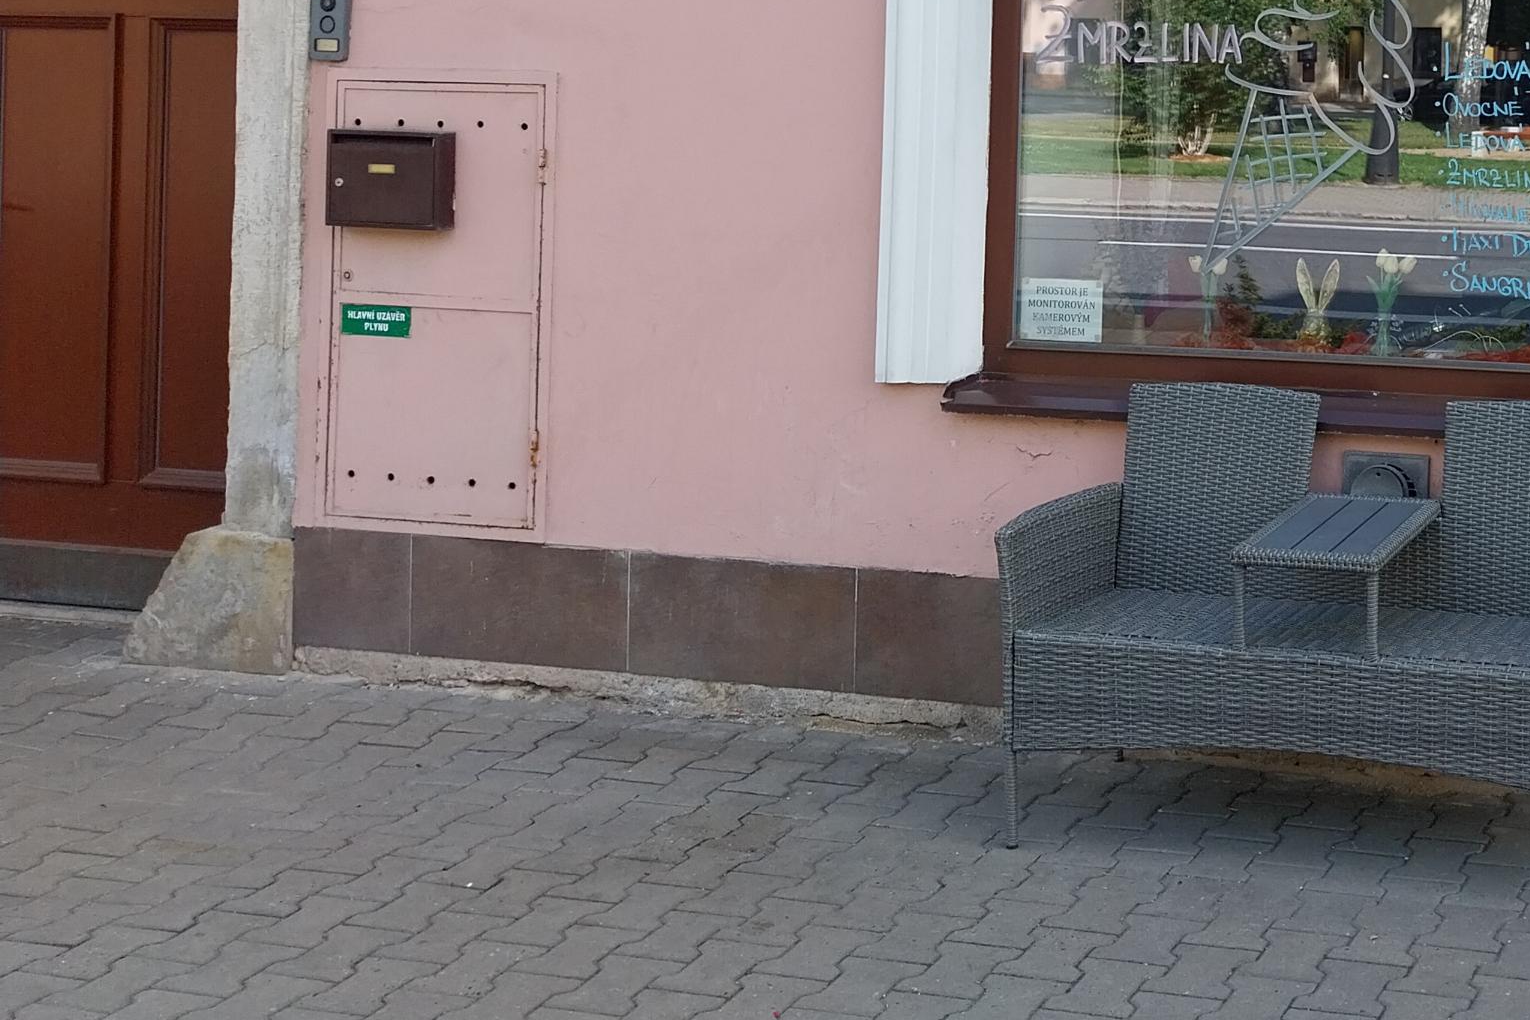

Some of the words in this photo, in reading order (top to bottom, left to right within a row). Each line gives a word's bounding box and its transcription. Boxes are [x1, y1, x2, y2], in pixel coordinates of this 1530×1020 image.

[1036, 4, 1243, 65] ZMRZLINA
[1036, 286, 1077, 296] PROSTOR
[1028, 299, 1095, 309] MONITOROVÁN
[347, 310, 375, 320] HLAVNÍ
[1032, 312, 1090, 323] KAMEROVÝM
[364, 322, 389, 331] PLYNU
[1036, 325, 1085, 336] SYSTÉMEM
